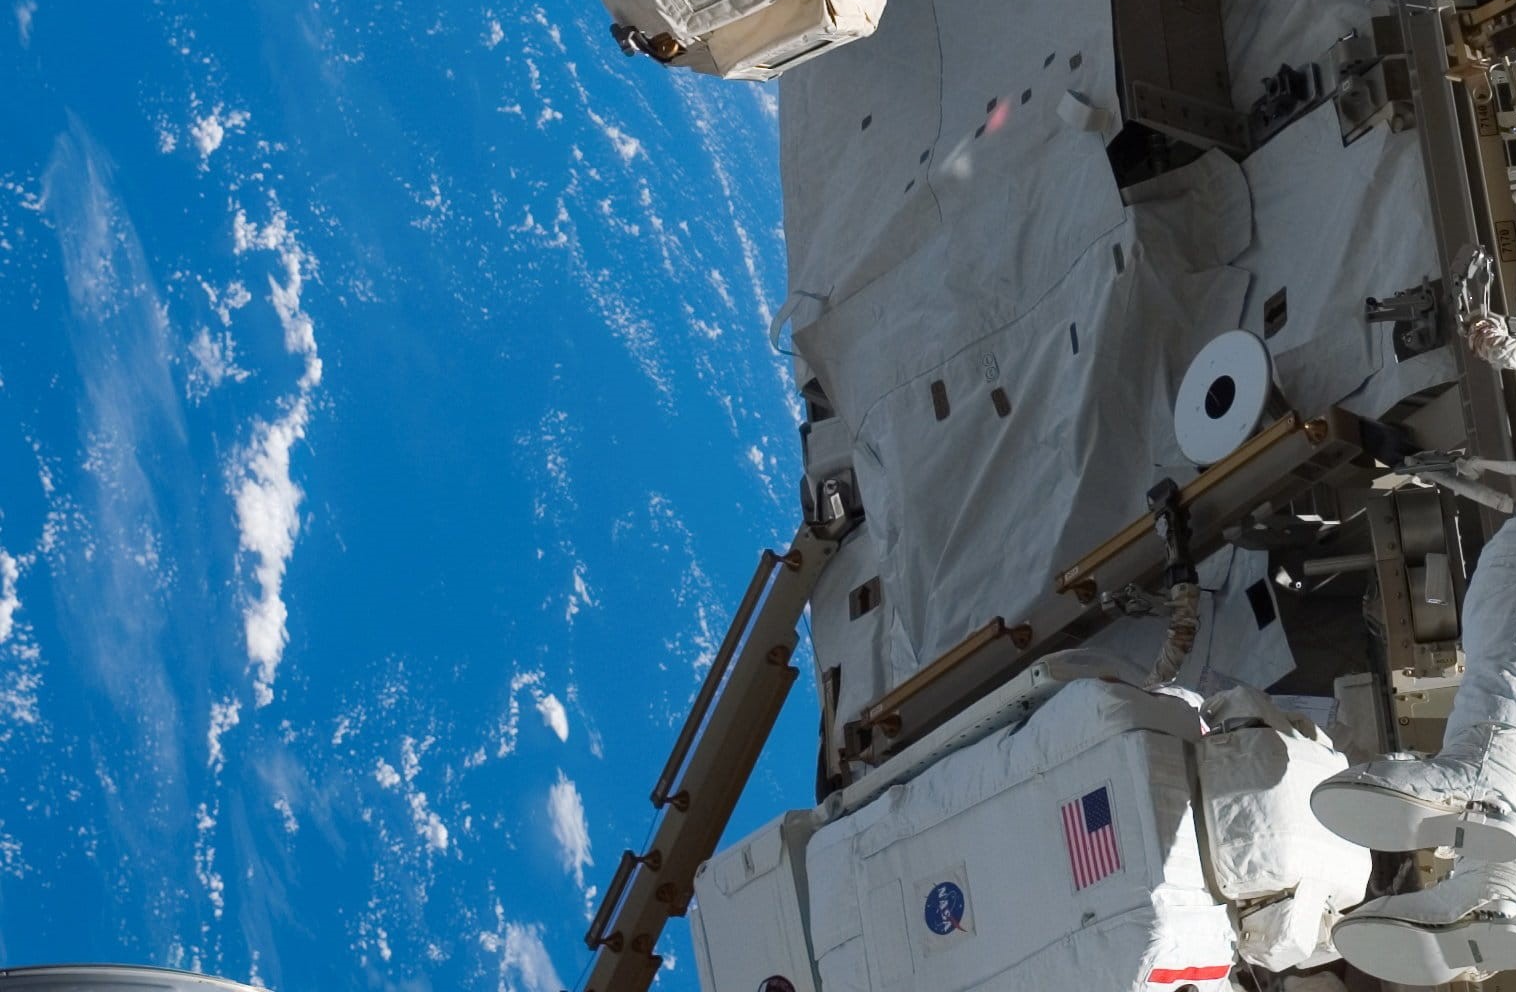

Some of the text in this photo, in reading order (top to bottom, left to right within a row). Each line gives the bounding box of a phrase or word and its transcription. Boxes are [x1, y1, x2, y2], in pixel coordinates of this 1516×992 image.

[1477, 104, 1490, 128] 7140
[1499, 229, 1513, 254] 7170
[939, 886, 953, 932] NASA
